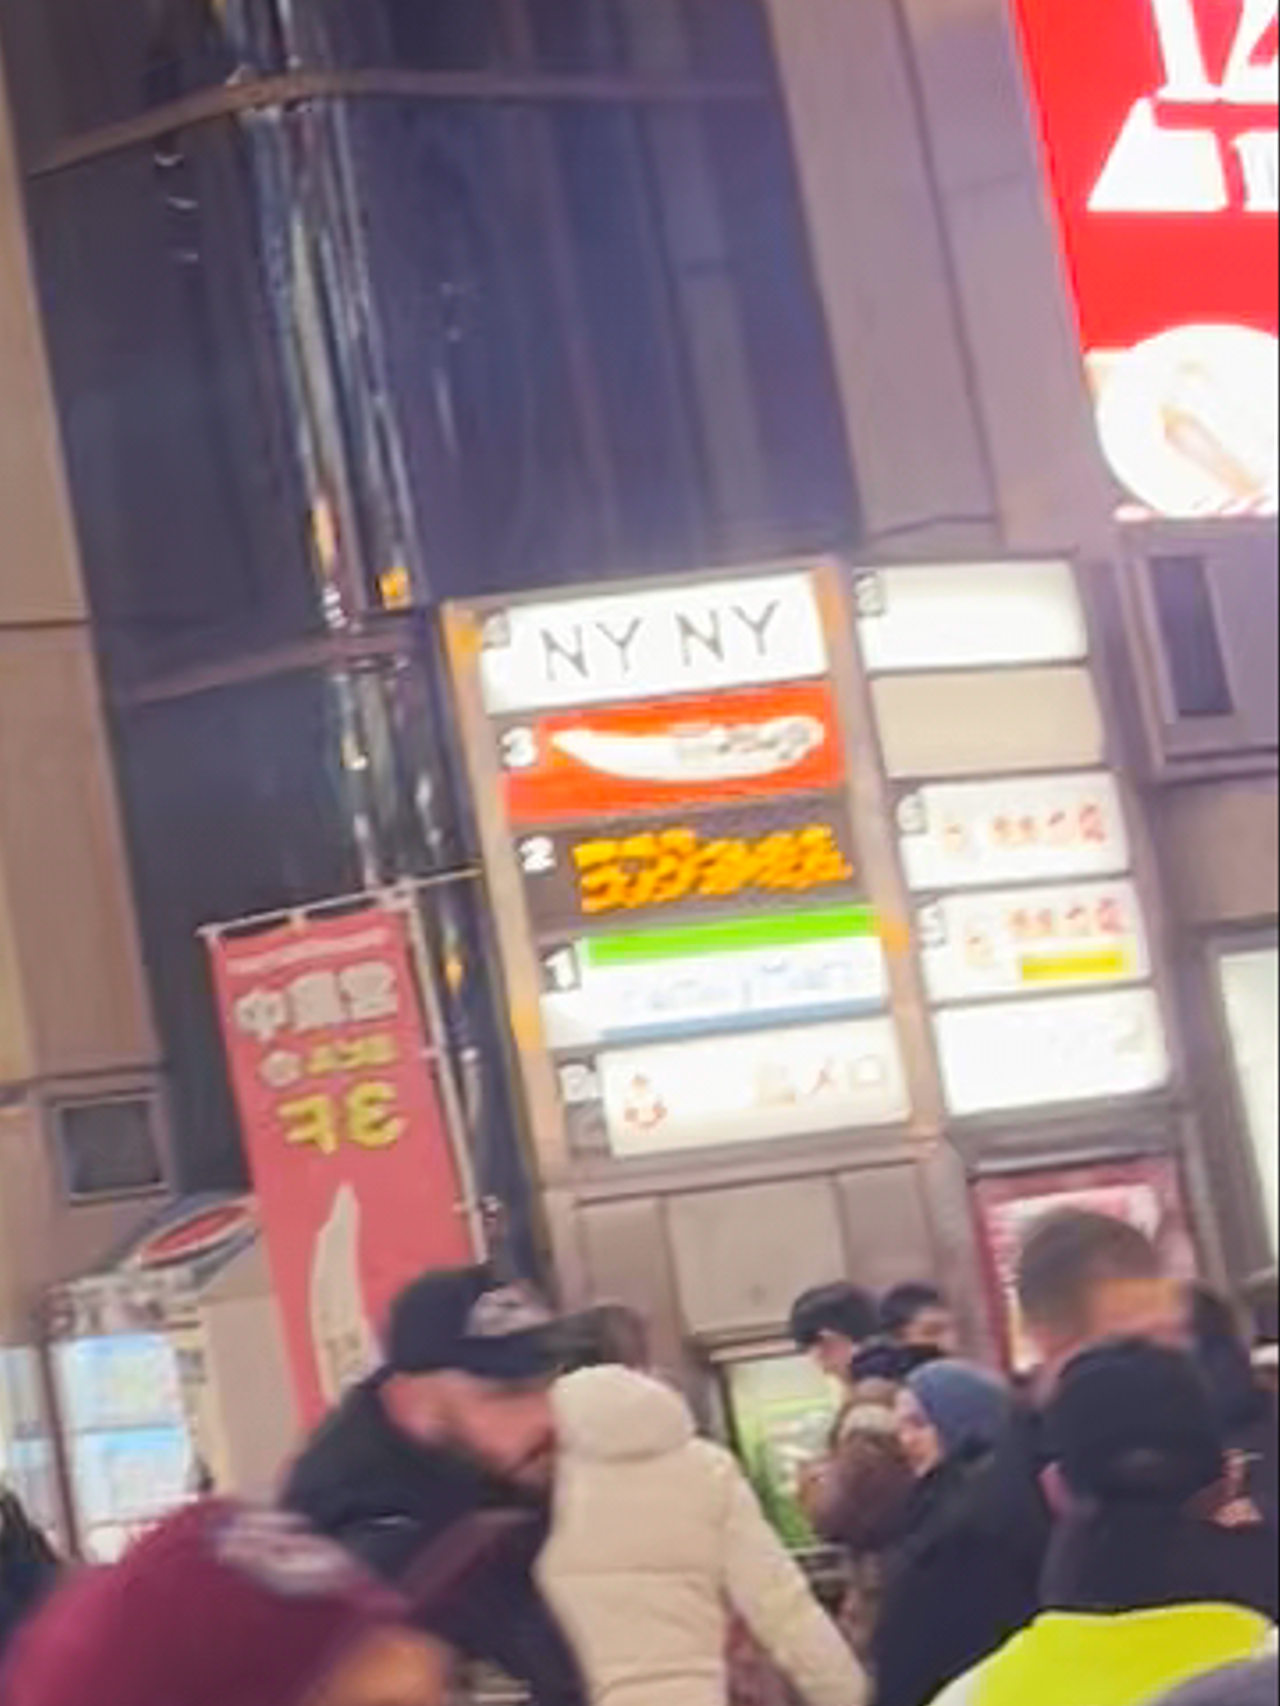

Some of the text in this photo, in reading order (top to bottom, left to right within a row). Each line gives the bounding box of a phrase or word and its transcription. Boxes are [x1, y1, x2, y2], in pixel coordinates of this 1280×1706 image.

[540, 615, 645, 682] NY
[673, 598, 782, 668] NY
[519, 835, 556, 873] 2
